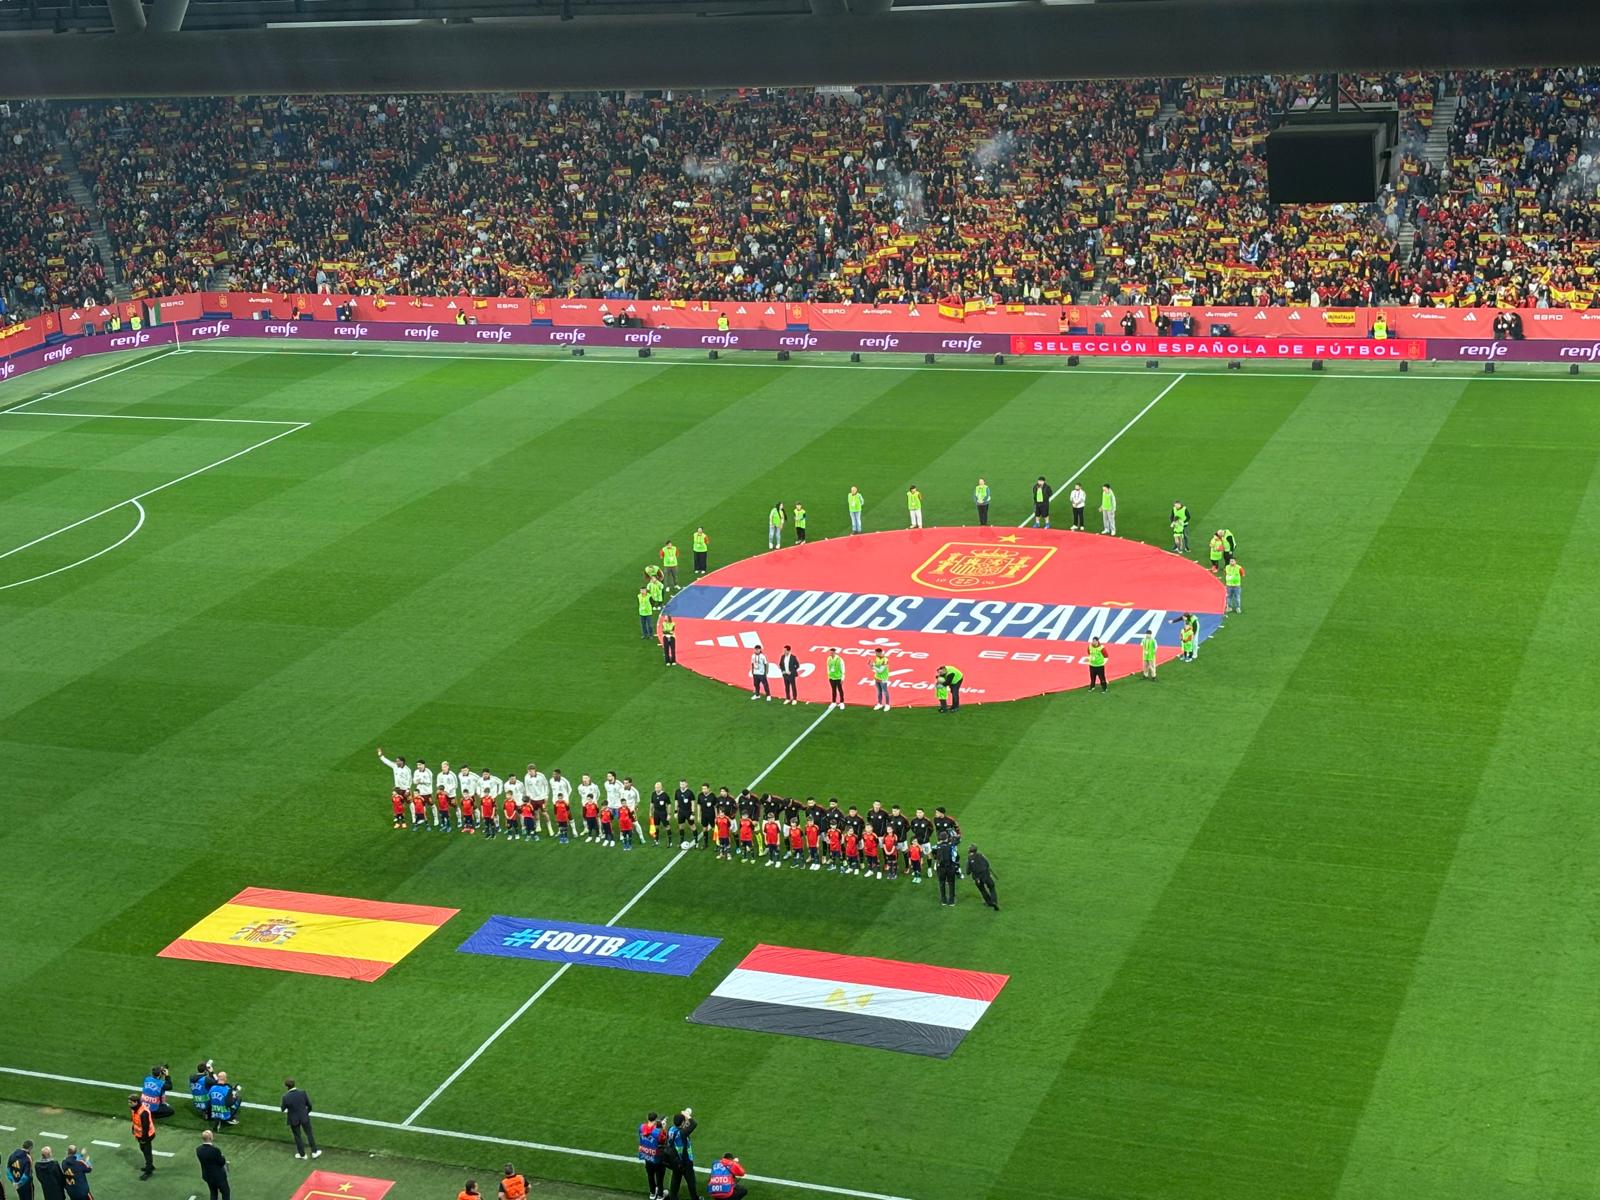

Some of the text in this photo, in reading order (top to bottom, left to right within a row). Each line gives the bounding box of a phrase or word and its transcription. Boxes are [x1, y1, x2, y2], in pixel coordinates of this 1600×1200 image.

[192, 320, 230, 336] renfe
[264, 322, 298, 337] renfe
[334, 324, 368, 339] renfe
[404, 325, 440, 341] renfe
[476, 326, 512, 342] renfe
[550, 328, 586, 344] renfe
[110, 331, 150, 348] renfe
[624, 330, 662, 346] renfe
[701, 331, 739, 348] renfe
[779, 333, 818, 349] renfe
[859, 334, 899, 350] renfe
[941, 335, 983, 352] renfe
[44, 343, 73, 362] renfe
[1033, 339, 1400, 356] SELECCIÓN ESPAÑOLA DE FÚTBOL
[1459, 341, 1508, 360] renfe
[0, 361, 15, 379] nfe
[704, 586, 1167, 645] VAMOS ESPAÑA
[809, 645, 929, 660] mapfre
[857, 677, 937, 691] Hlcó
[502, 928, 681, 963] #FOOTBALL
